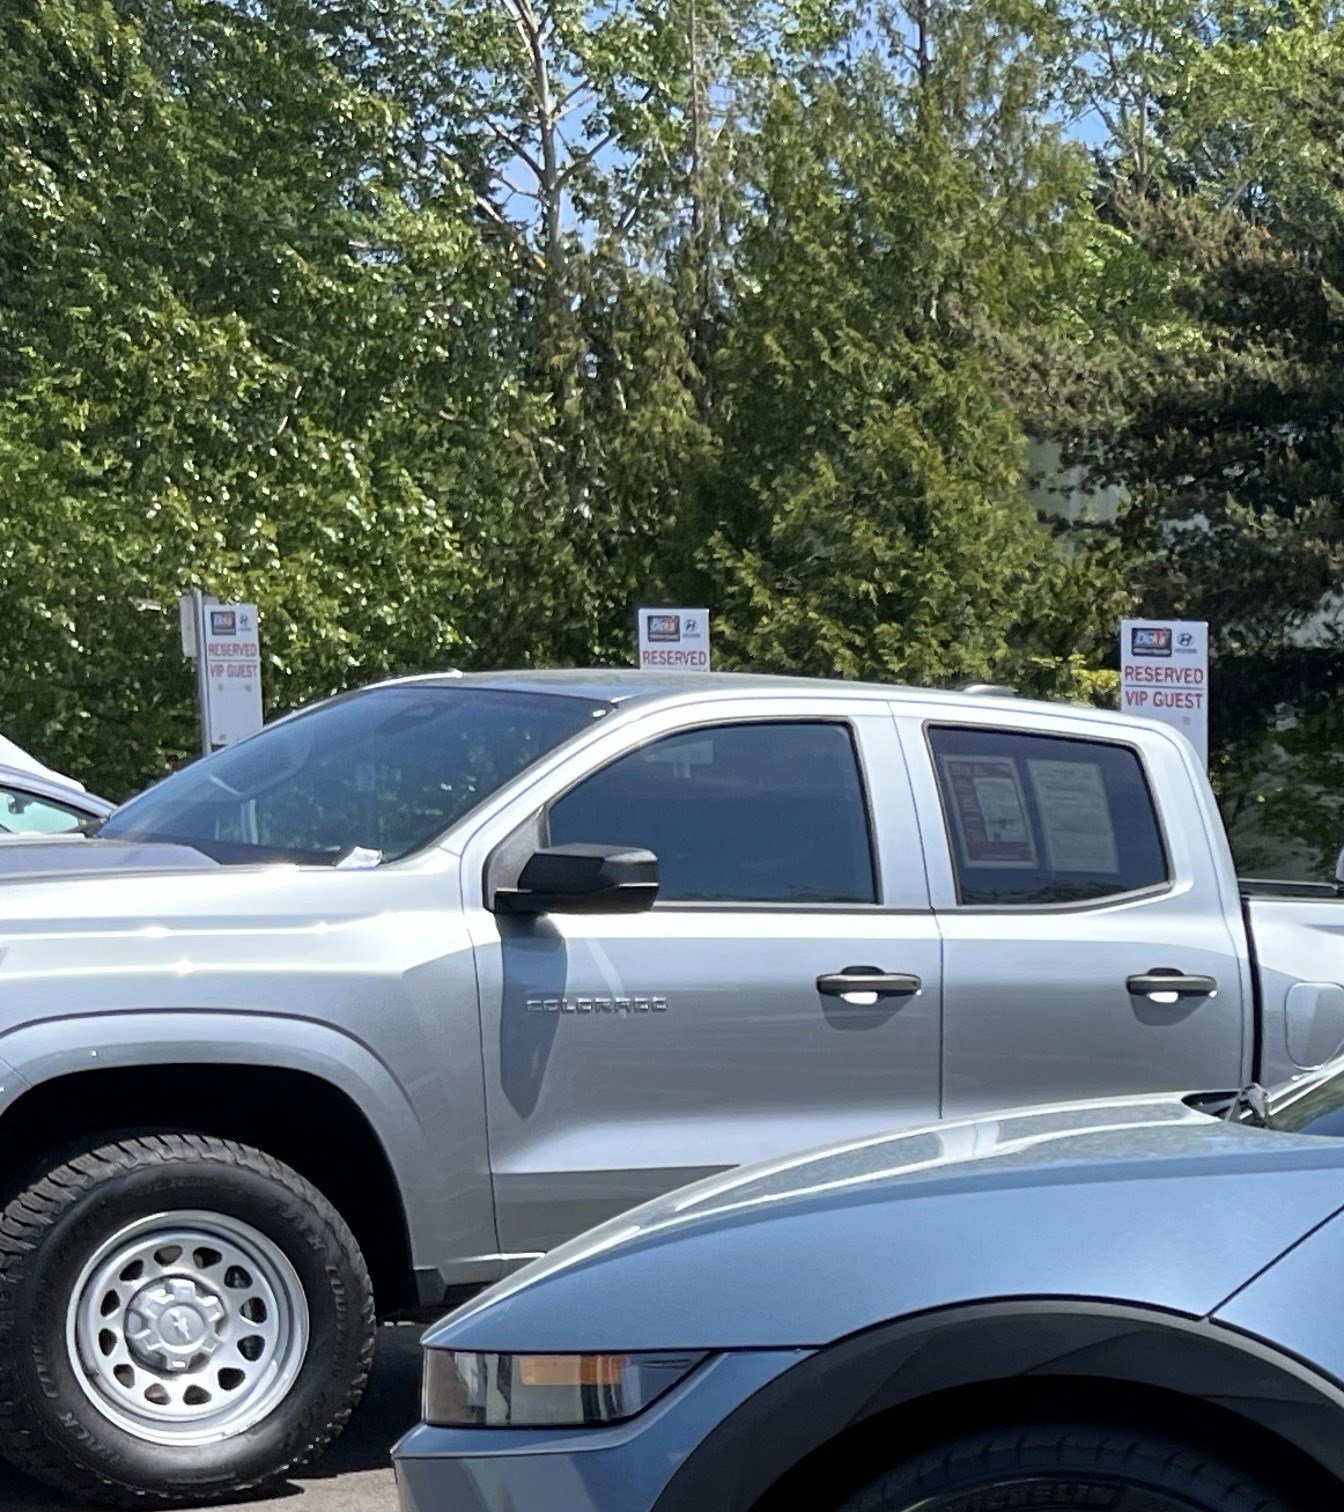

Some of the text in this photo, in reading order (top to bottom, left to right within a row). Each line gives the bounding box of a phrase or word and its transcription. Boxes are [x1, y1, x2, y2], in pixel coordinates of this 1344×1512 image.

[208, 644, 257, 658] RESERVED
[643, 651, 706, 666] RESERVED
[210, 664, 258, 679] VIP GUEST
[1125, 666, 1204, 684] RESERVED
[1126, 692, 1203, 709] VIP GUEST
